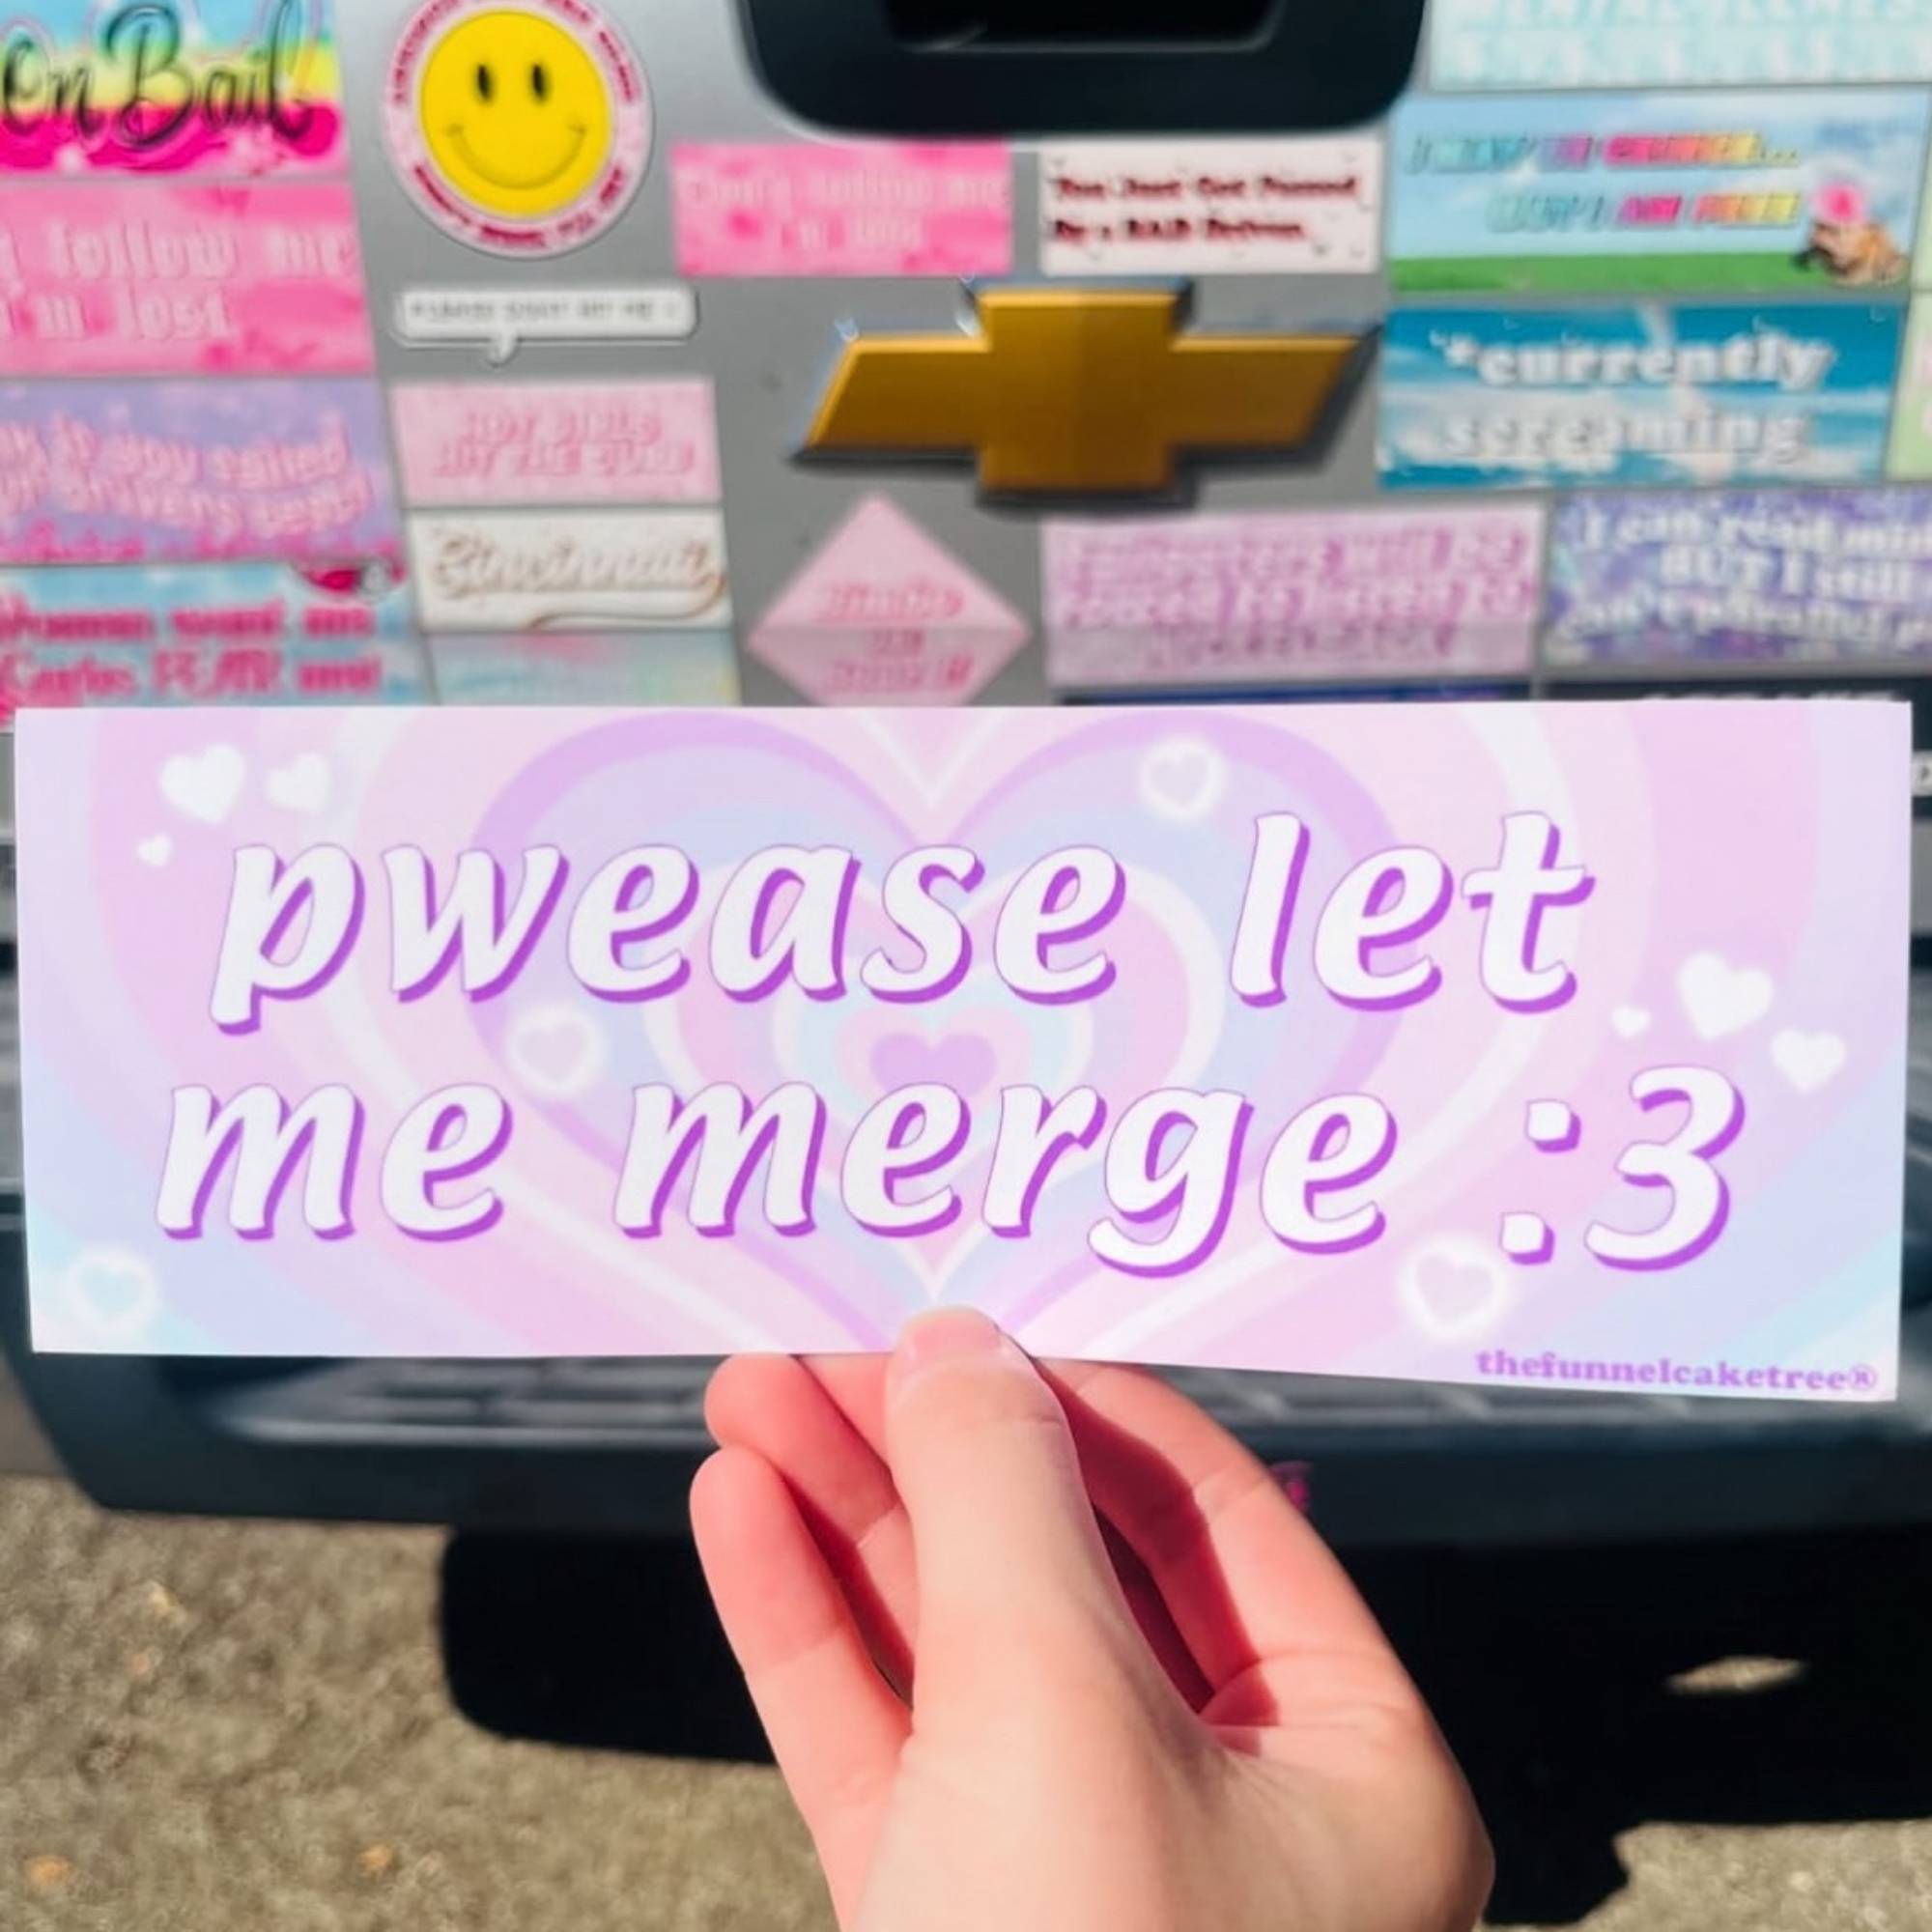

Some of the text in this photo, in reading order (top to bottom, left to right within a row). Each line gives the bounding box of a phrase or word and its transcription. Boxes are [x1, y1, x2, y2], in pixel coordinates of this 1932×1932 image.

[2, 37, 102, 140] On
[102, 0, 319, 153] Bail
[209, 811, 1595, 1035] pwease let
[156, 1064, 1746, 1279] me merge :3
